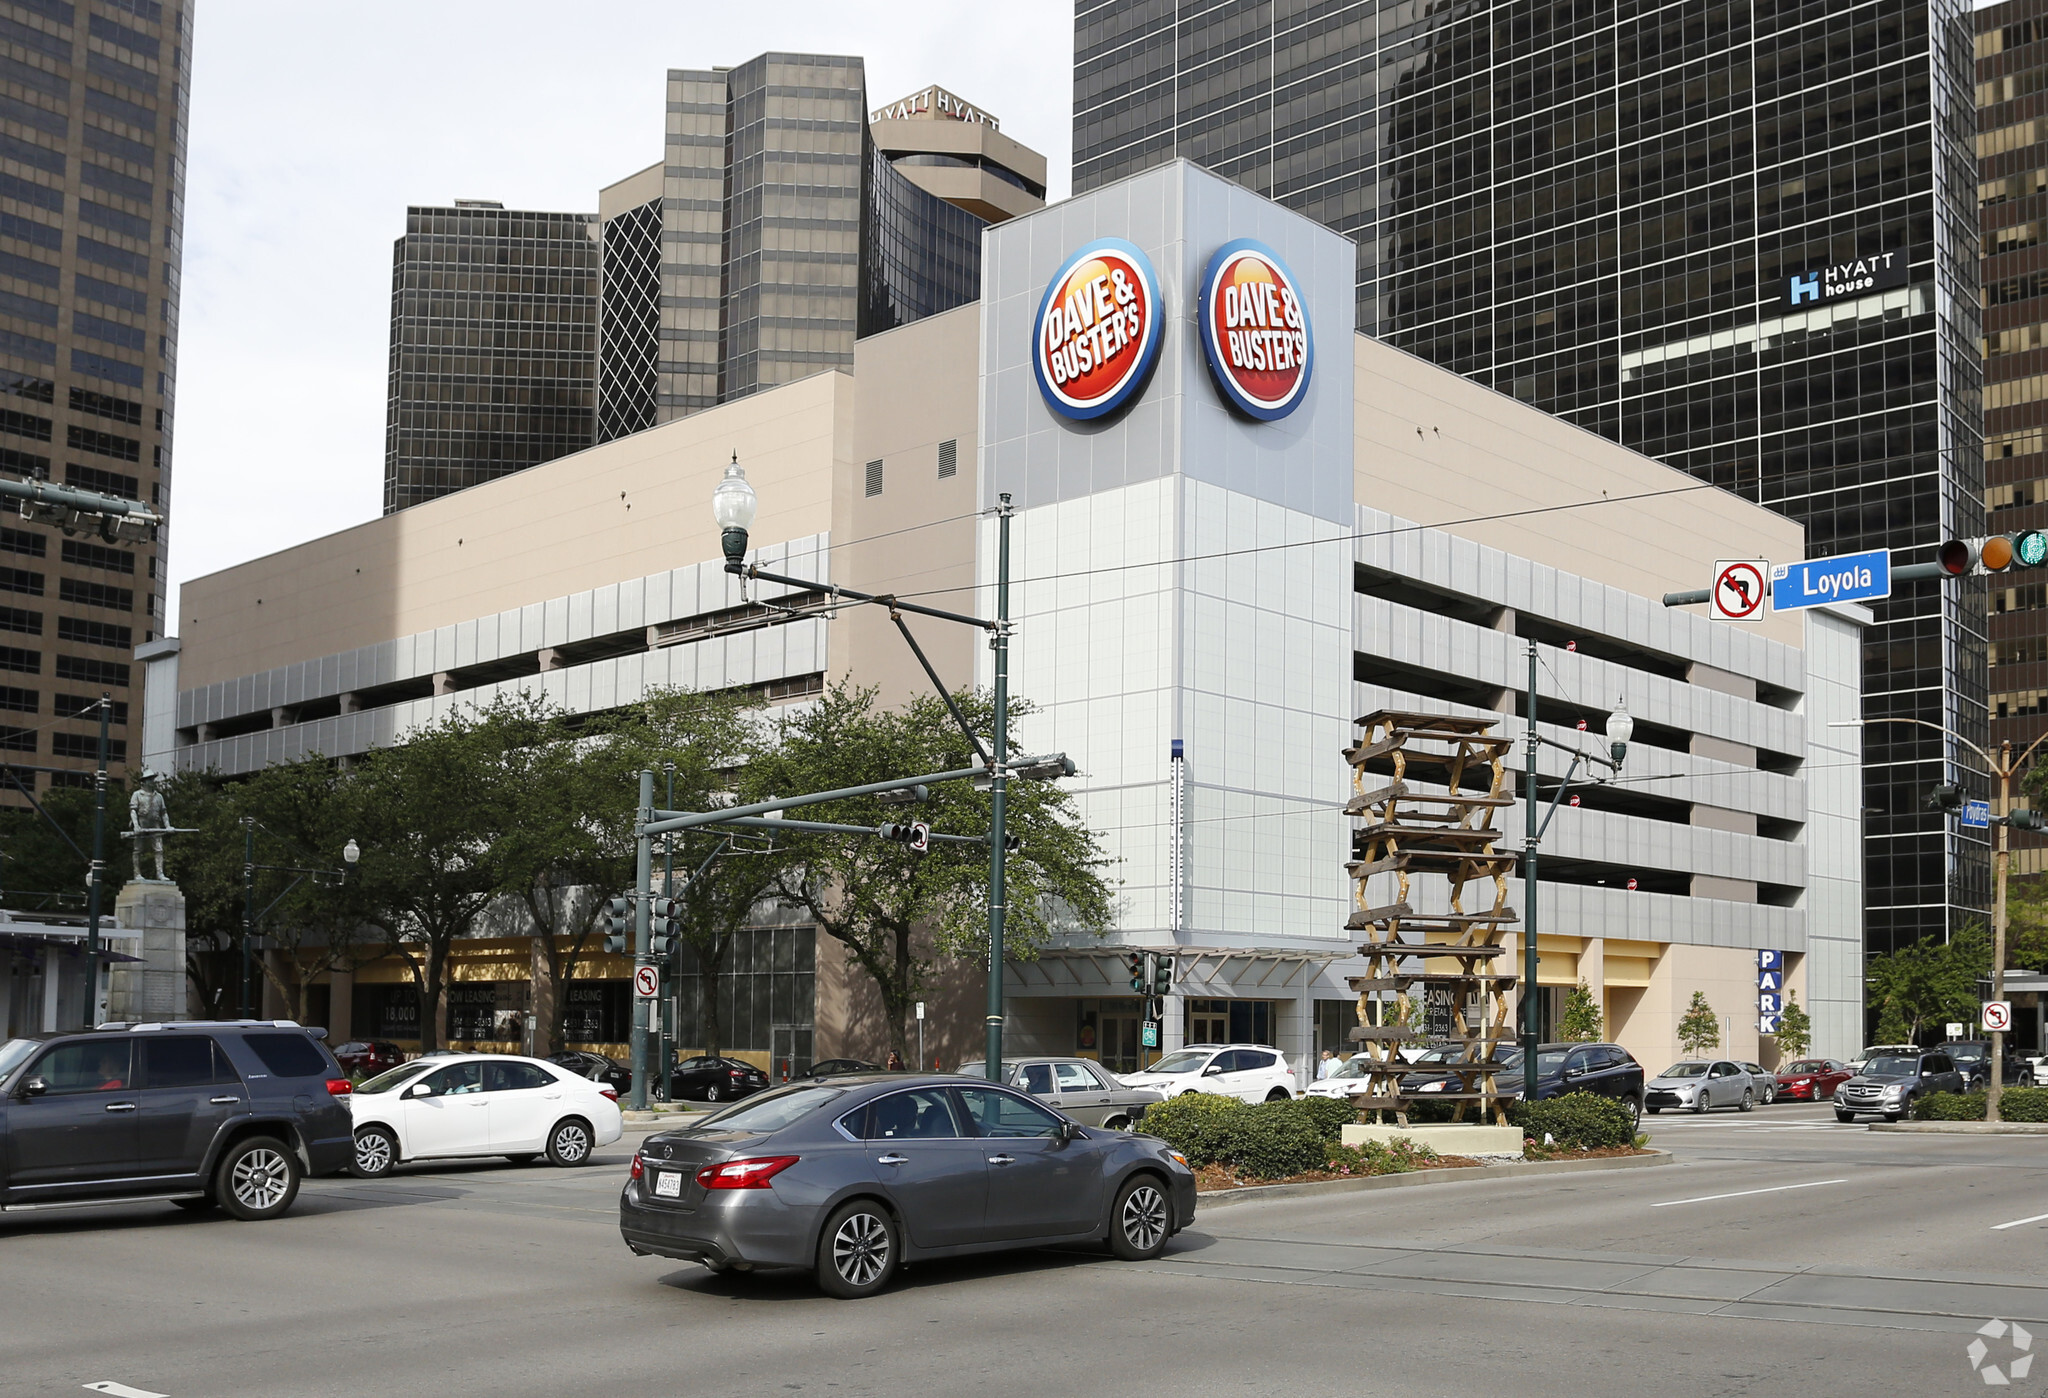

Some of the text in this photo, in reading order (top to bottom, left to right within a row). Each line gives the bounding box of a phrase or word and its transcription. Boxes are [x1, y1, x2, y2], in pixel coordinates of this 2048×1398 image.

[869, 89, 932, 125] HYATT
[937, 90, 999, 130] HYATT
[1825, 252, 1894, 284] HYATT
[1825, 277, 1874, 297] house
[1048, 268, 1137, 353] DAVE &
[1225, 282, 1301, 330] DAVE &
[1050, 301, 1140, 386] BUSTER'S
[1228, 329, 1305, 372] BUSTER'S
[1803, 565, 1872, 598] Loyola
[464, 990, 496, 1003] LEASING
[570, 989, 602, 1002] LEASING
[1760, 951, 1776, 1033] PARK
[385, 1006, 415, 1022] 18,000
